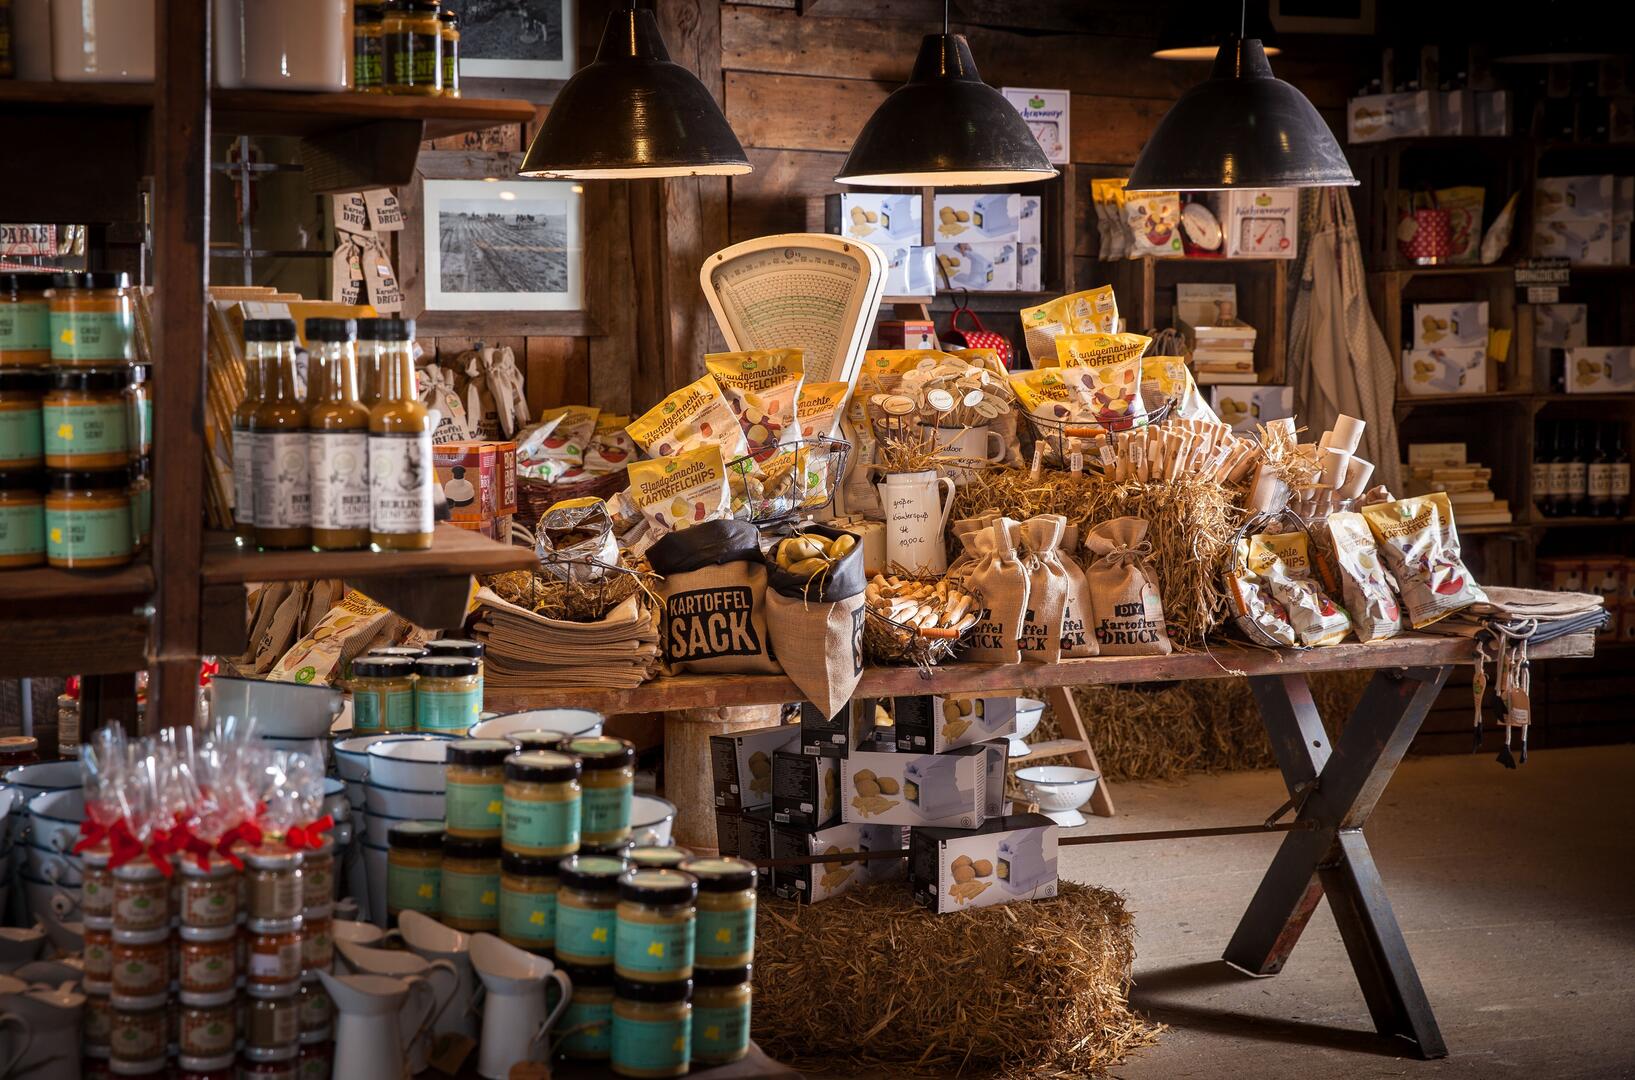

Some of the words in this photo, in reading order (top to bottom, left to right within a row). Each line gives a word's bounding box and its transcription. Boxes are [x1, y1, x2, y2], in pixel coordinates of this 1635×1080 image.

[343, 212, 366, 225] DRUC
[0, 227, 48, 244] PARIS
[642, 390, 702, 441] Handgemachte
[639, 468, 716, 508] KARTOFFELCHIPS
[640, 461, 706, 495] Handgemachte
[670, 590, 749, 616] KARTOFFEL
[1120, 606, 1140, 615] DIY
[671, 611, 756, 658] SACK
[1100, 629, 1160, 645] DRUCK
